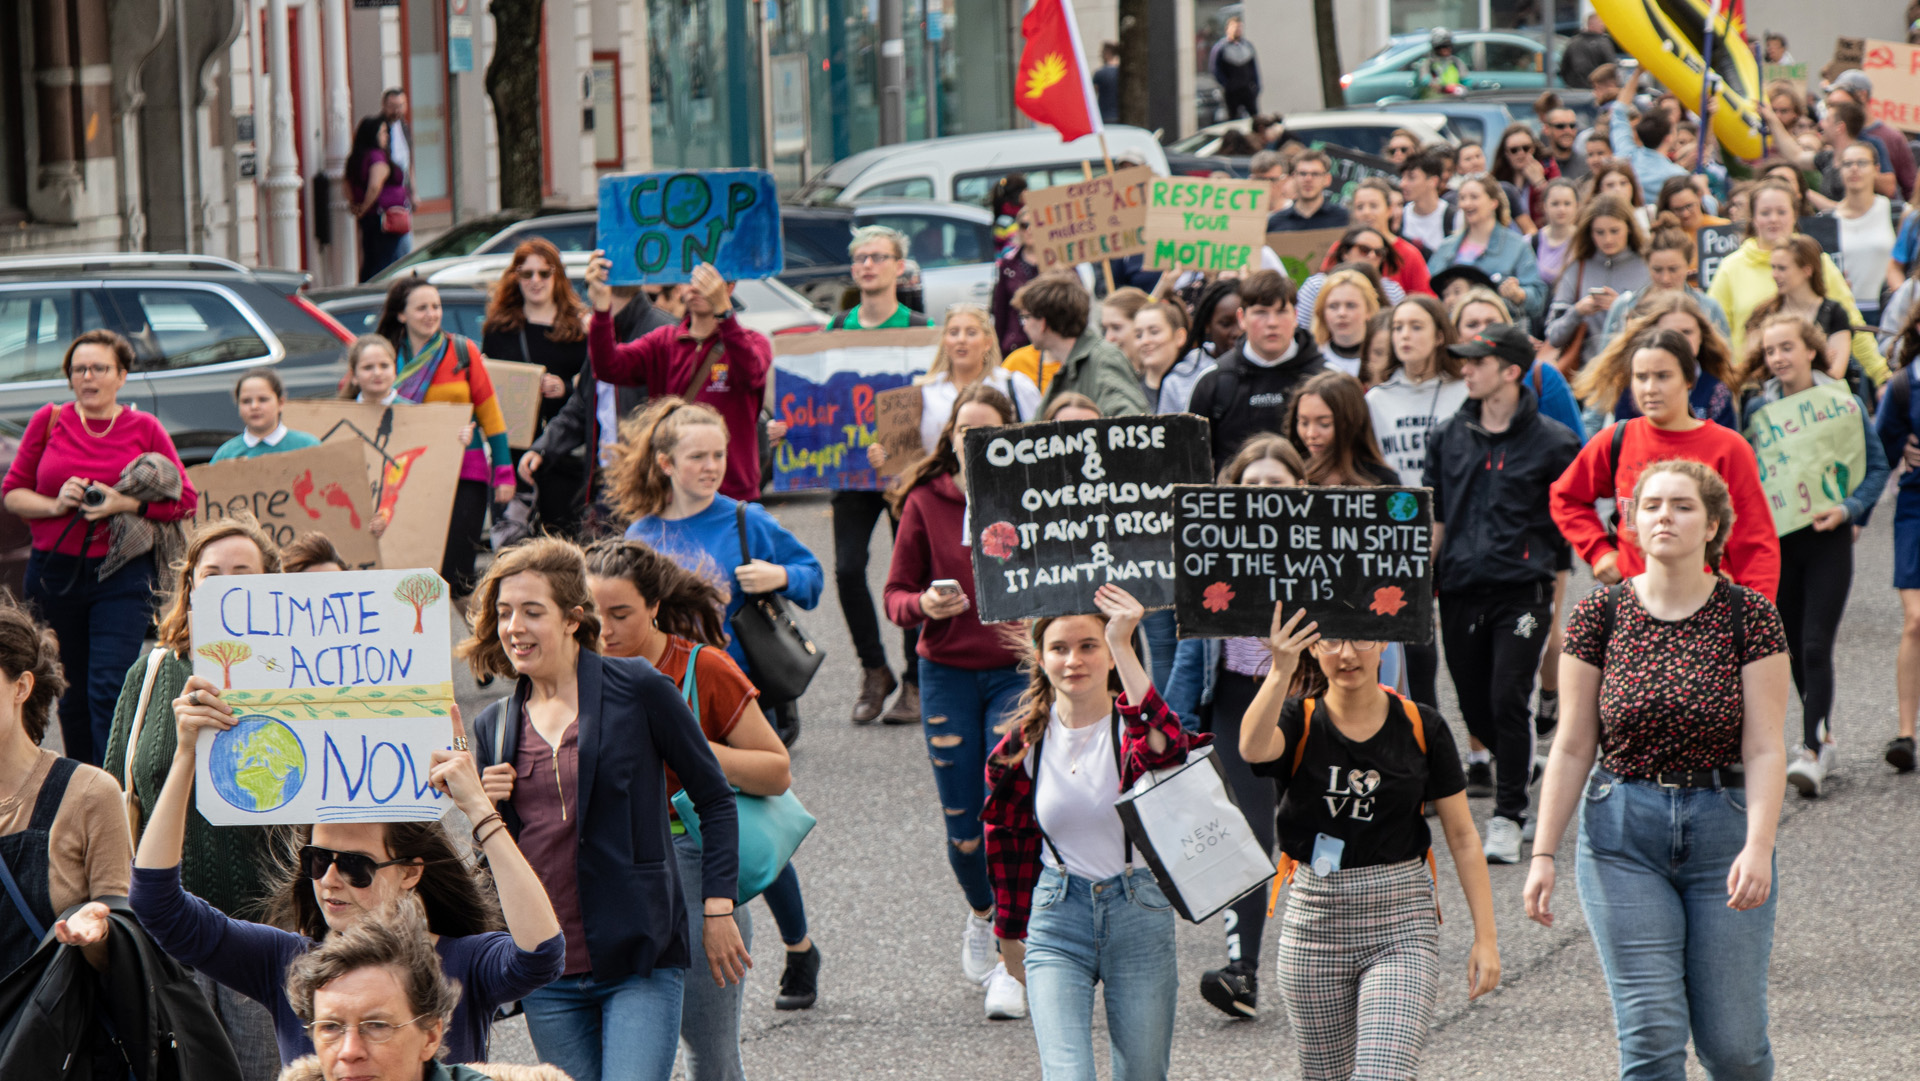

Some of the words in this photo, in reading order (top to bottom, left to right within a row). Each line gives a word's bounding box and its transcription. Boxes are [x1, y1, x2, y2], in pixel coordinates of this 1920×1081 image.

[630, 173, 757, 231] COP
[1032, 196, 1096, 228] LITTLE
[1112, 182, 1148, 212] ACT
[1153, 181, 1265, 211] RESPECT
[1182, 212, 1230, 231] YOUR
[635, 216, 724, 274] ON
[1042, 226, 1147, 267] DIFFERENC
[1153, 238, 1252, 270] MOTHER
[780, 392, 840, 429] Solar
[852, 384, 877, 427] Po
[1799, 396, 1858, 426] Maths
[986, 427, 1097, 467] OCEANS
[1108, 425, 1166, 450] RISE
[1081, 452, 1106, 480] &
[1021, 482, 1174, 511] OVERFLOW
[1181, 492, 1237, 519] SEE
[1247, 493, 1314, 519] HOW
[1325, 494, 1377, 519] THE
[1018, 522, 1039, 549] IT
[1044, 514, 1109, 541] AIN'T
[1115, 511, 1174, 536] RIGH
[1182, 523, 1278, 549] COULD
[1290, 525, 1322, 550] BE
[1332, 526, 1358, 551] IN
[1364, 525, 1428, 552] SPITE
[1091, 541, 1114, 567] &
[1183, 553, 1219, 576] OF
[1226, 553, 1277, 577] THE
[1284, 553, 1345, 578] WAY
[1357, 553, 1429, 578] THAT
[1004, 567, 1029, 593] IT
[1106, 560, 1176, 582] NATU
[1270, 577, 1299, 601] IT
[1312, 578, 1334, 601] IS
[221, 588, 380, 636] CLIMATE
[289, 643, 413, 688] ACTION
[1180, 818, 1219, 847] NEW
[1184, 827, 1231, 860] LOOK
